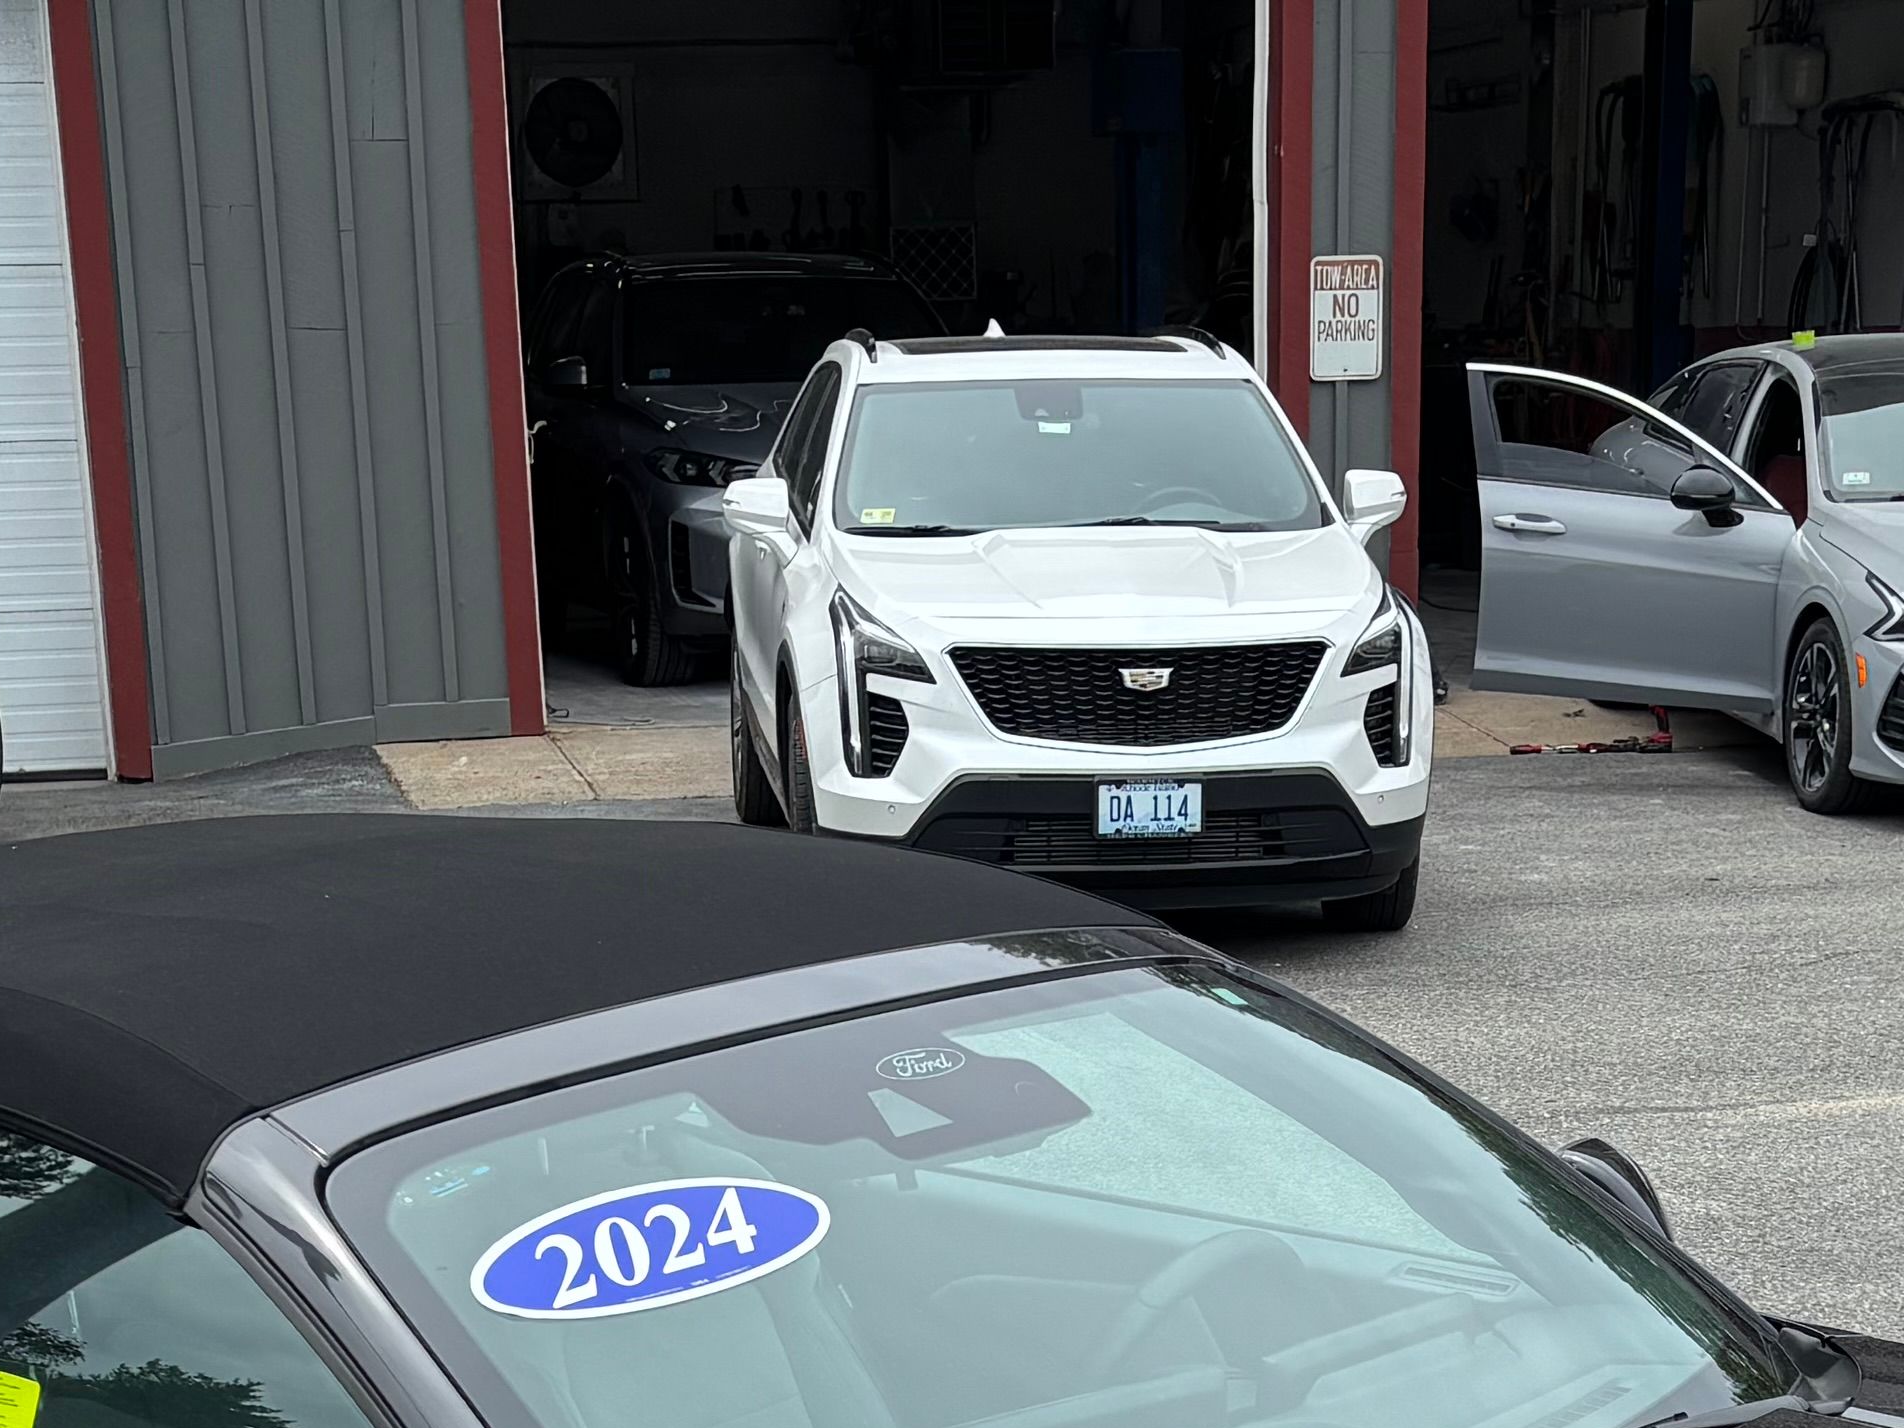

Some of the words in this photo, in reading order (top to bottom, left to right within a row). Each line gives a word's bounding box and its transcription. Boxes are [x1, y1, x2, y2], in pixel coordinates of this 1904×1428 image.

[1332, 292, 1360, 319] NO
[1317, 318, 1376, 342] PARKING
[1109, 795, 1135, 822] DA
[1150, 794, 1189, 822] 114
[893, 1051, 953, 1077] Ford
[534, 1186, 758, 1310] 2024
